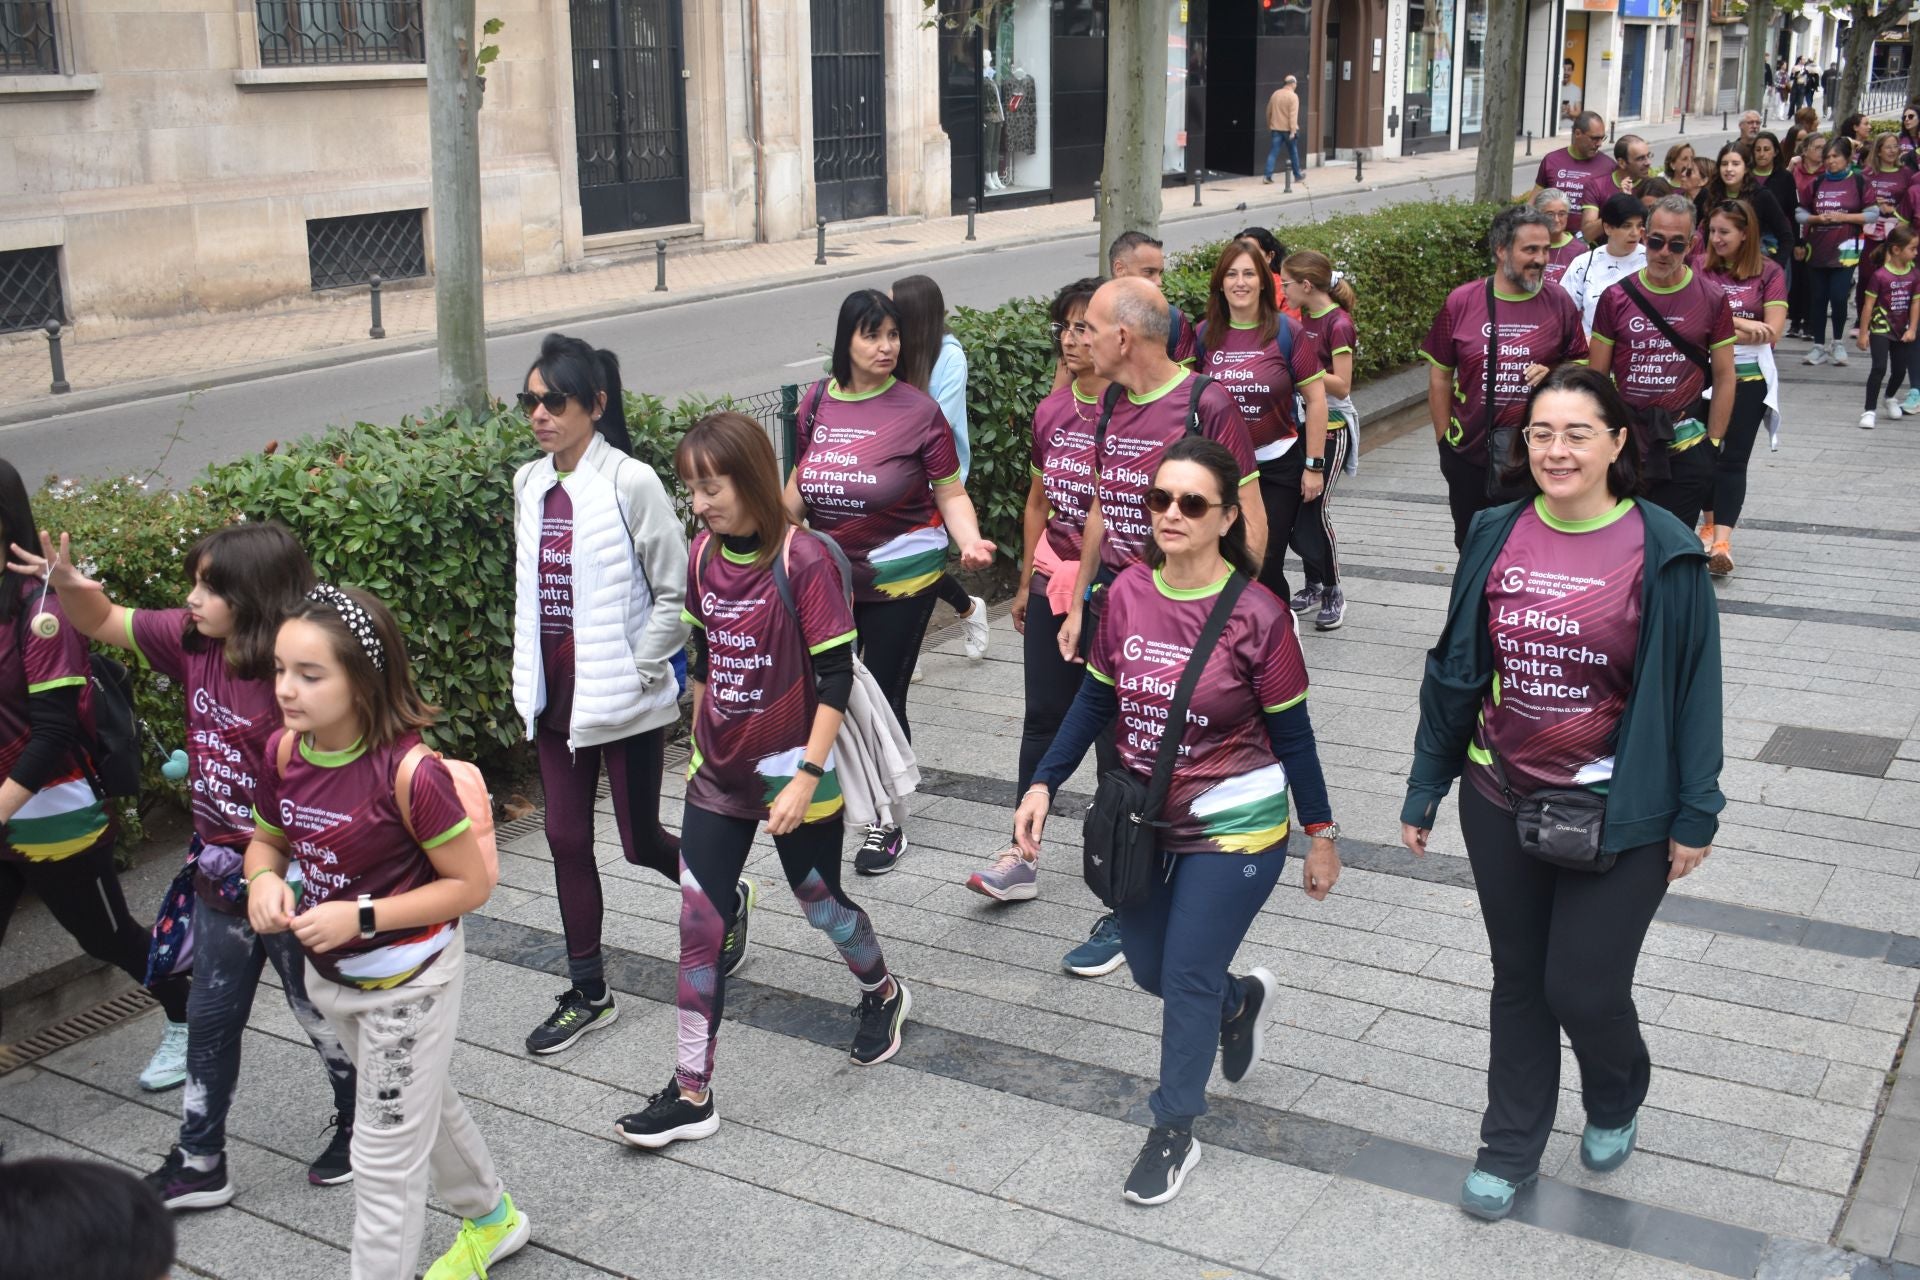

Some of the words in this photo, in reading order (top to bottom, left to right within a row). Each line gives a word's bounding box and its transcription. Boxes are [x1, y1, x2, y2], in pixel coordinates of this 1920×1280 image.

[1728, 299, 1743, 308] oja
[1732, 310, 1755, 319] rcha
[1500, 345, 1530, 358] Rioja
[1631, 340, 1646, 349] La
[1500, 361, 1536, 371] marc
[1224, 369, 1254, 381] Rioja
[1481, 371, 1520, 382] cntra
[1626, 373, 1636, 383] el
[1638, 374, 1678, 385] cáncer
[1240, 405, 1261, 413] ncer
[808, 451, 822, 463] La
[824, 451, 858, 467] Rioja
[1045, 456, 1059, 469] La
[1061, 458, 1091, 476] Rioja
[802, 467, 817, 480] En
[820, 471, 877, 485] marcha
[1101, 465, 1113, 481] La
[1116, 467, 1149, 487] Rioja
[801, 481, 845, 495] contra
[1043, 473, 1055, 487] En
[1058, 478, 1096, 497] march
[817, 495, 866, 509] cáncer
[1100, 485, 1114, 501] En
[1116, 491, 1145, 505] mar
[1101, 504, 1142, 519] contra
[1115, 519, 1153, 535] cánce
[543, 548, 572, 567] Rioja
[545, 573, 574, 586] marc
[1527, 578, 1552, 587] contra
[1553, 581, 1560, 589] el
[1561, 583, 1588, 592] cáncer
[1530, 571, 1569, 582] asociación
[1570, 576, 1606, 587] española
[538, 586, 569, 601] ontra
[1536, 586, 1546, 595] La
[1547, 588, 1567, 599] Rioja
[1498, 605, 1519, 626] La
[1524, 609, 1580, 637] Rioja
[719, 630, 756, 650] Rioja
[1146, 640, 1179, 651] asociación
[1145, 648, 1164, 656] contra
[1497, 632, 1519, 653] En
[1524, 641, 1608, 666] marcha
[722, 653, 773, 670] marcha
[1152, 655, 1160, 663] La
[720, 686, 763, 703] cáncer
[1120, 672, 1138, 691] La
[1142, 676, 1177, 701] Rioj
[1520, 678, 1590, 699] cáncer
[1121, 697, 1140, 714] En
[1128, 731, 1138, 748] el
[216, 799, 254, 819] ncer
[1555, 823, 1588, 835] Quechua
[302, 841, 338, 865] Rioja
[310, 863, 352, 889] march
